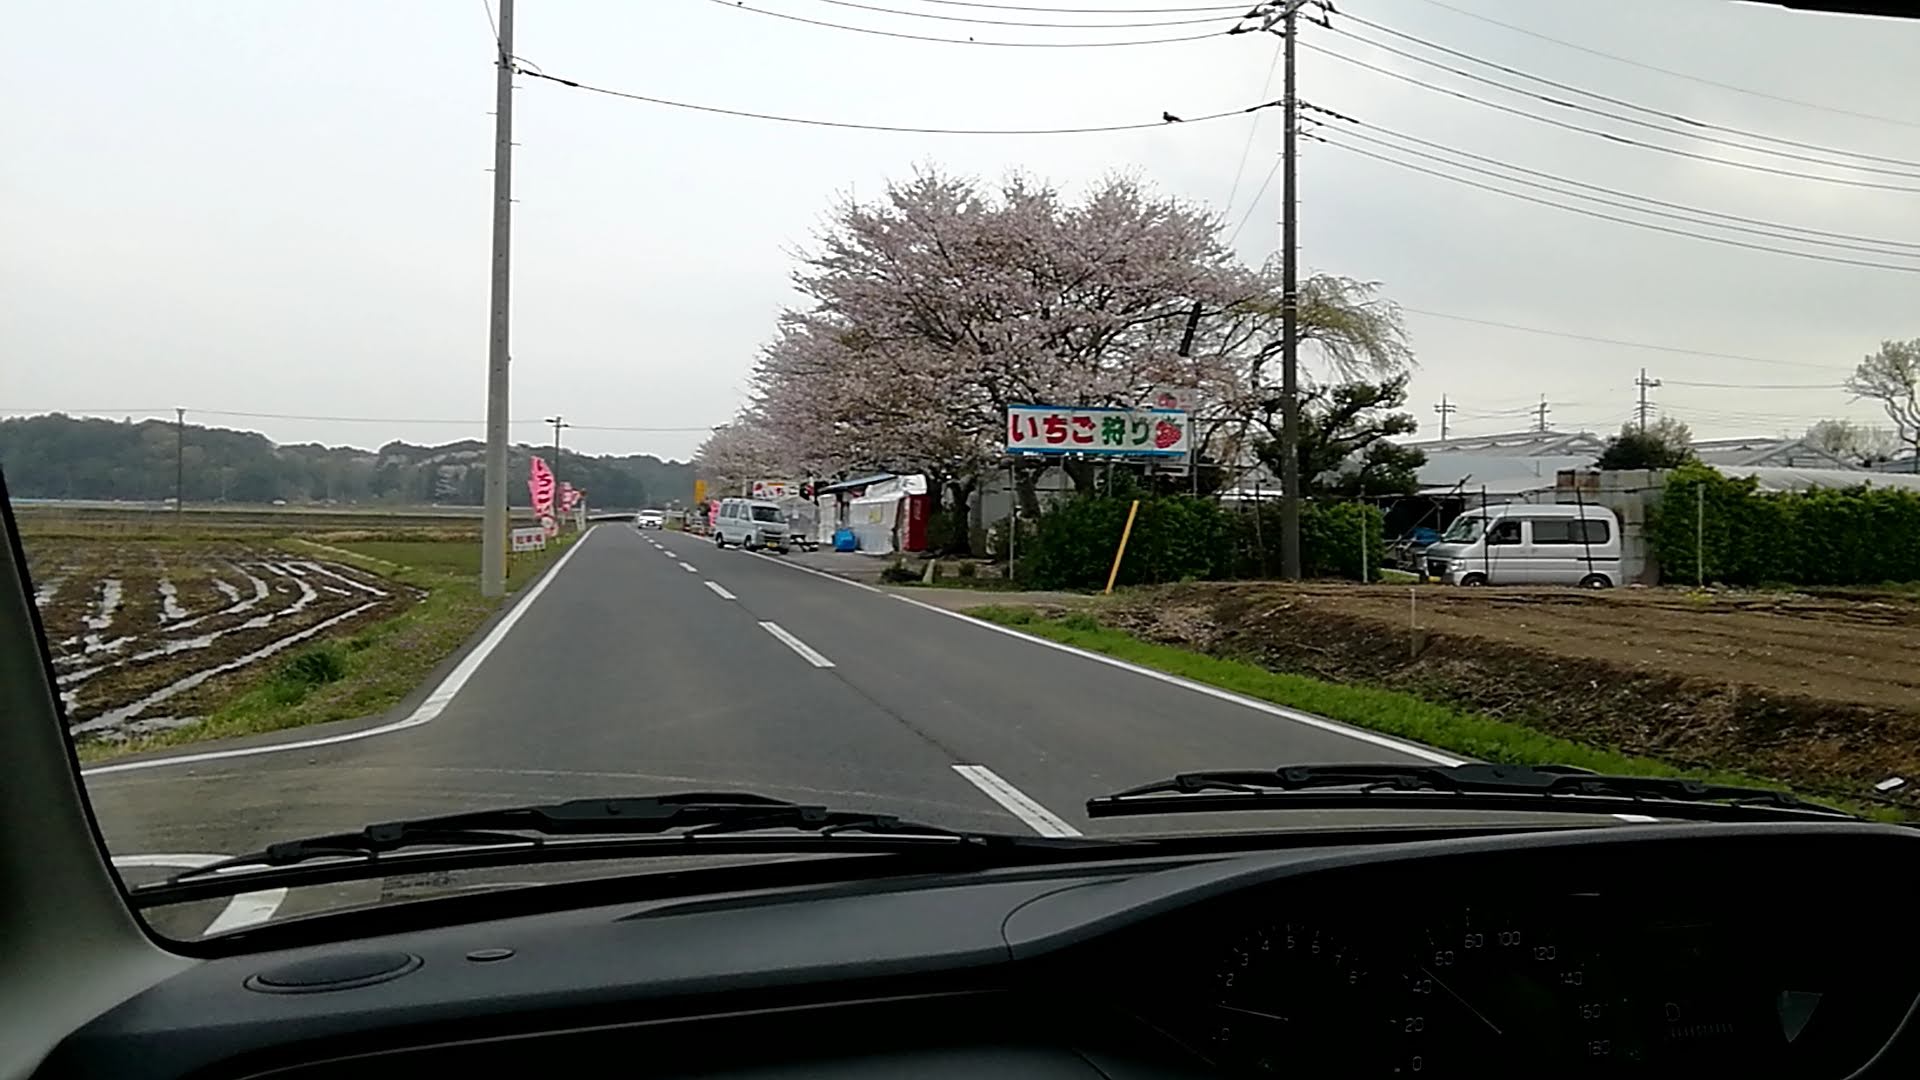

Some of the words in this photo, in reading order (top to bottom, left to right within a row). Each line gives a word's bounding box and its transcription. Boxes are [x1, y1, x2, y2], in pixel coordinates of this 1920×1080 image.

[1010, 413, 1150, 446] いちご狩り
[1287, 935, 1295, 949] 5
[1496, 931, 1521, 946] 100
[1241, 952, 1249, 966] 3
[1434, 950, 1455, 966] 60
[1533, 945, 1556, 961] 120
[1227, 972, 1235, 987] 2
[1405, 1016, 1424, 1032] 20
[1412, 1055, 1422, 1071] 0
